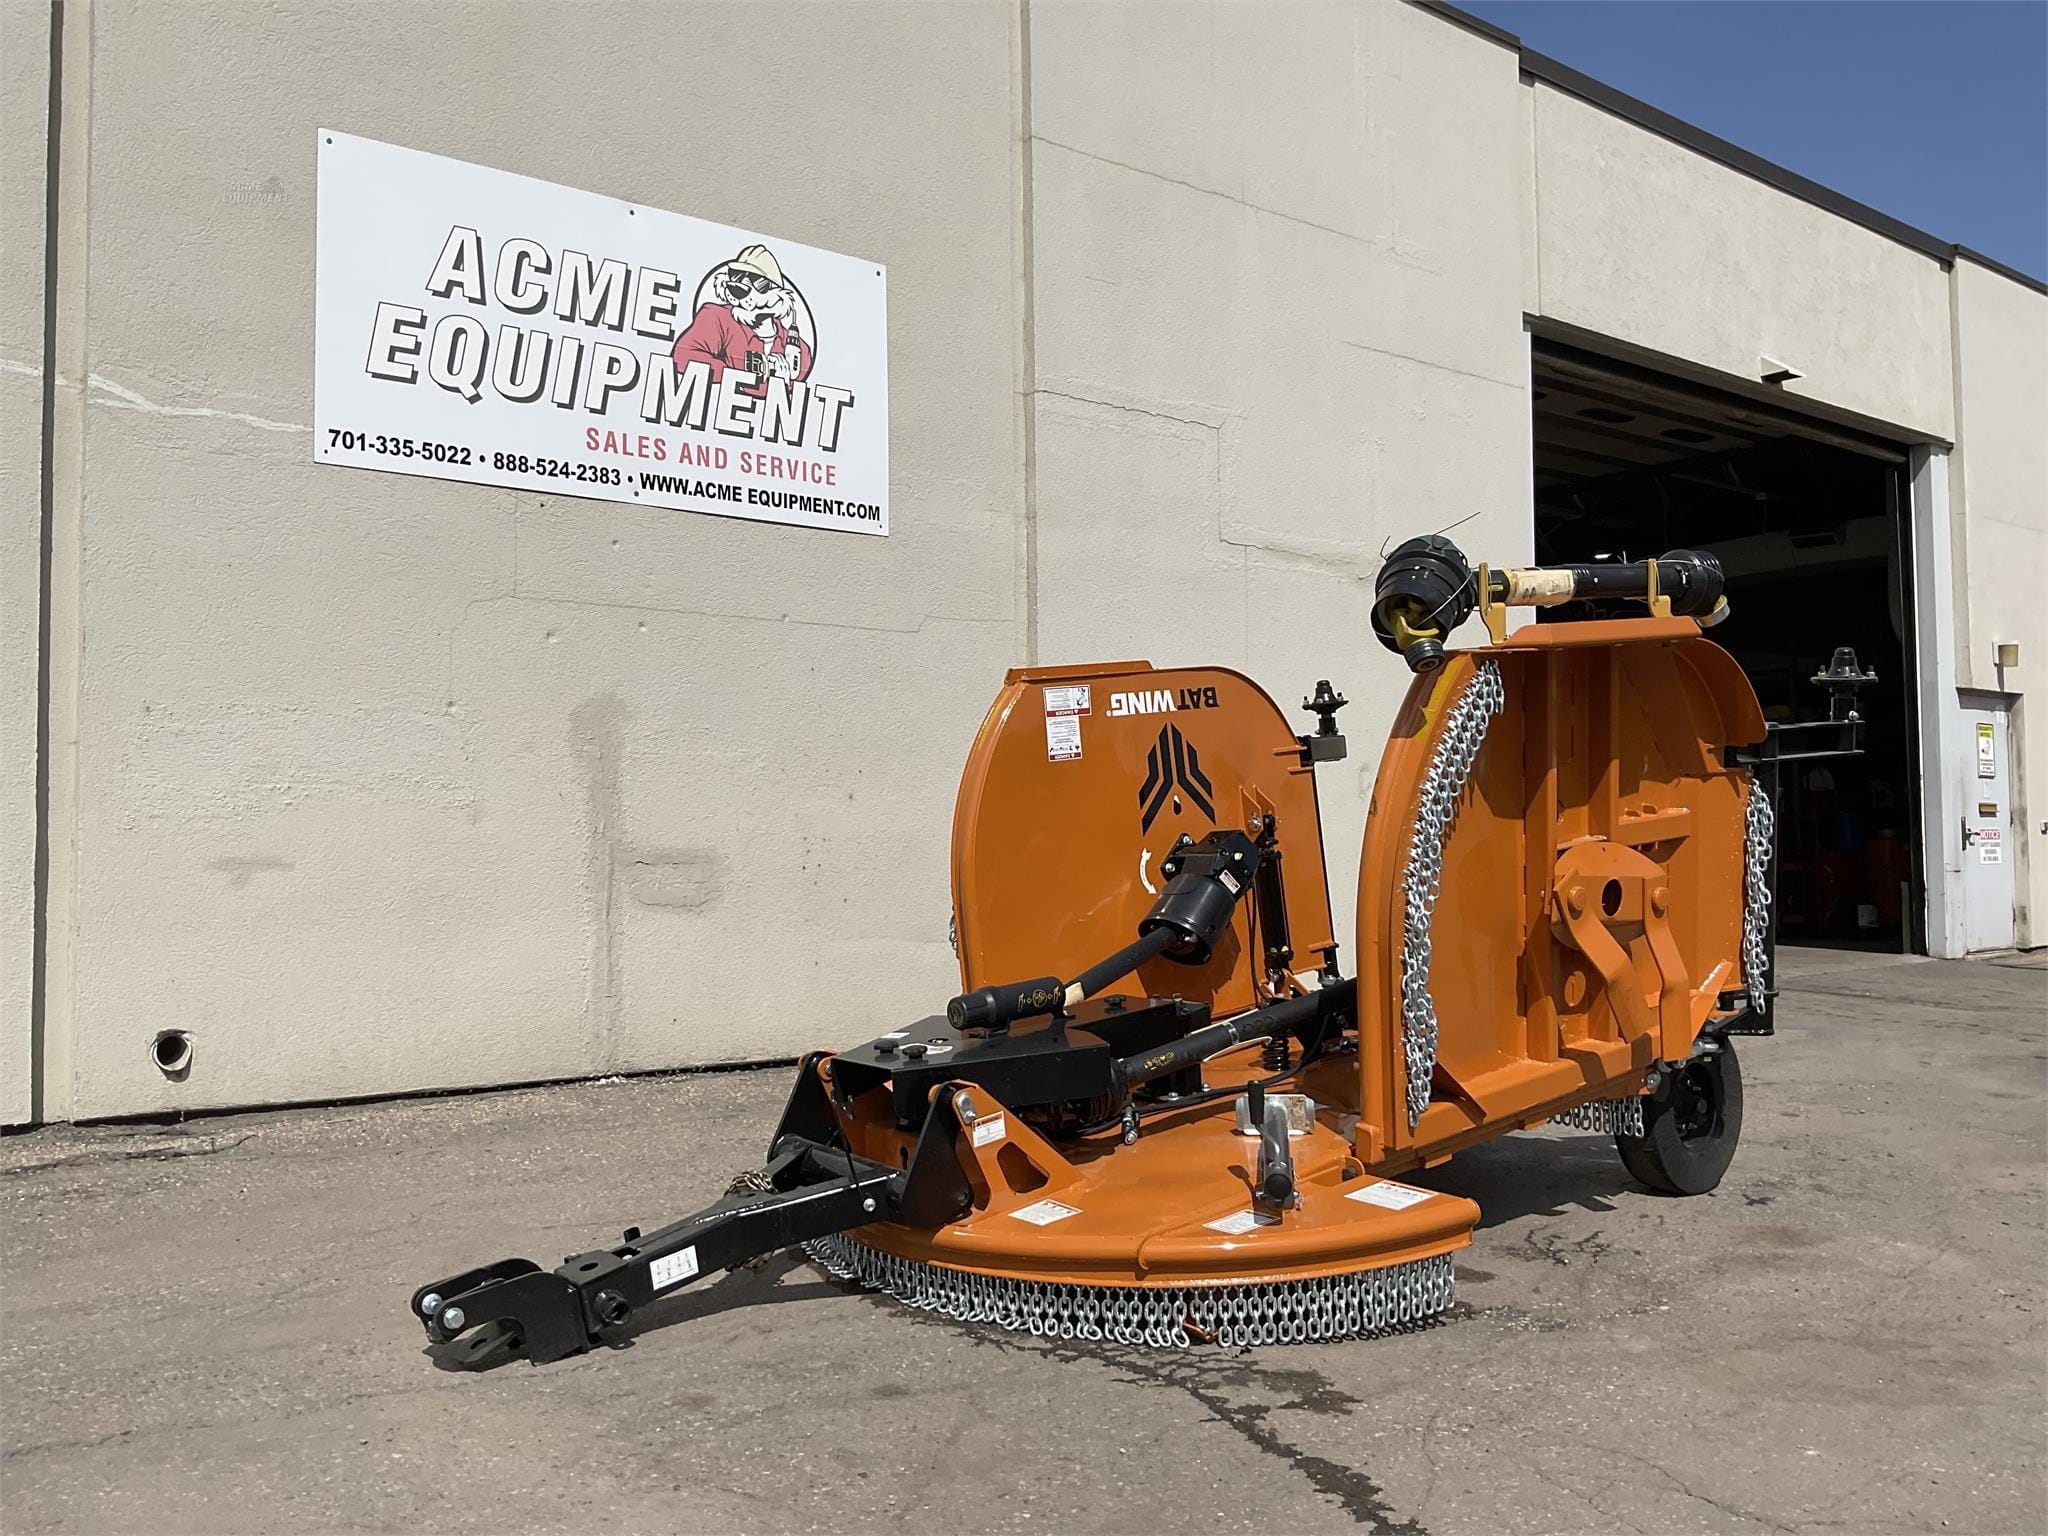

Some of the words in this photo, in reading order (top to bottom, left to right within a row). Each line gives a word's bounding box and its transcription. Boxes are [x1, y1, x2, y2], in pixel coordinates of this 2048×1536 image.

[425, 225, 682, 342] ACME
[365, 301, 855, 452] EQUIPMENT
[328, 428, 472, 465] 701-335-5022
[493, 452, 621, 485] 888-524-2383
[640, 472, 742, 503] WWW.ACME
[748, 488, 880, 521] EQUIPMENT.COM
[586, 427, 667, 461] SALES
[679, 442, 728, 469] AND
[740, 451, 836, 486] SERVICE
[1980, 830, 2000, 839] NOTICE
